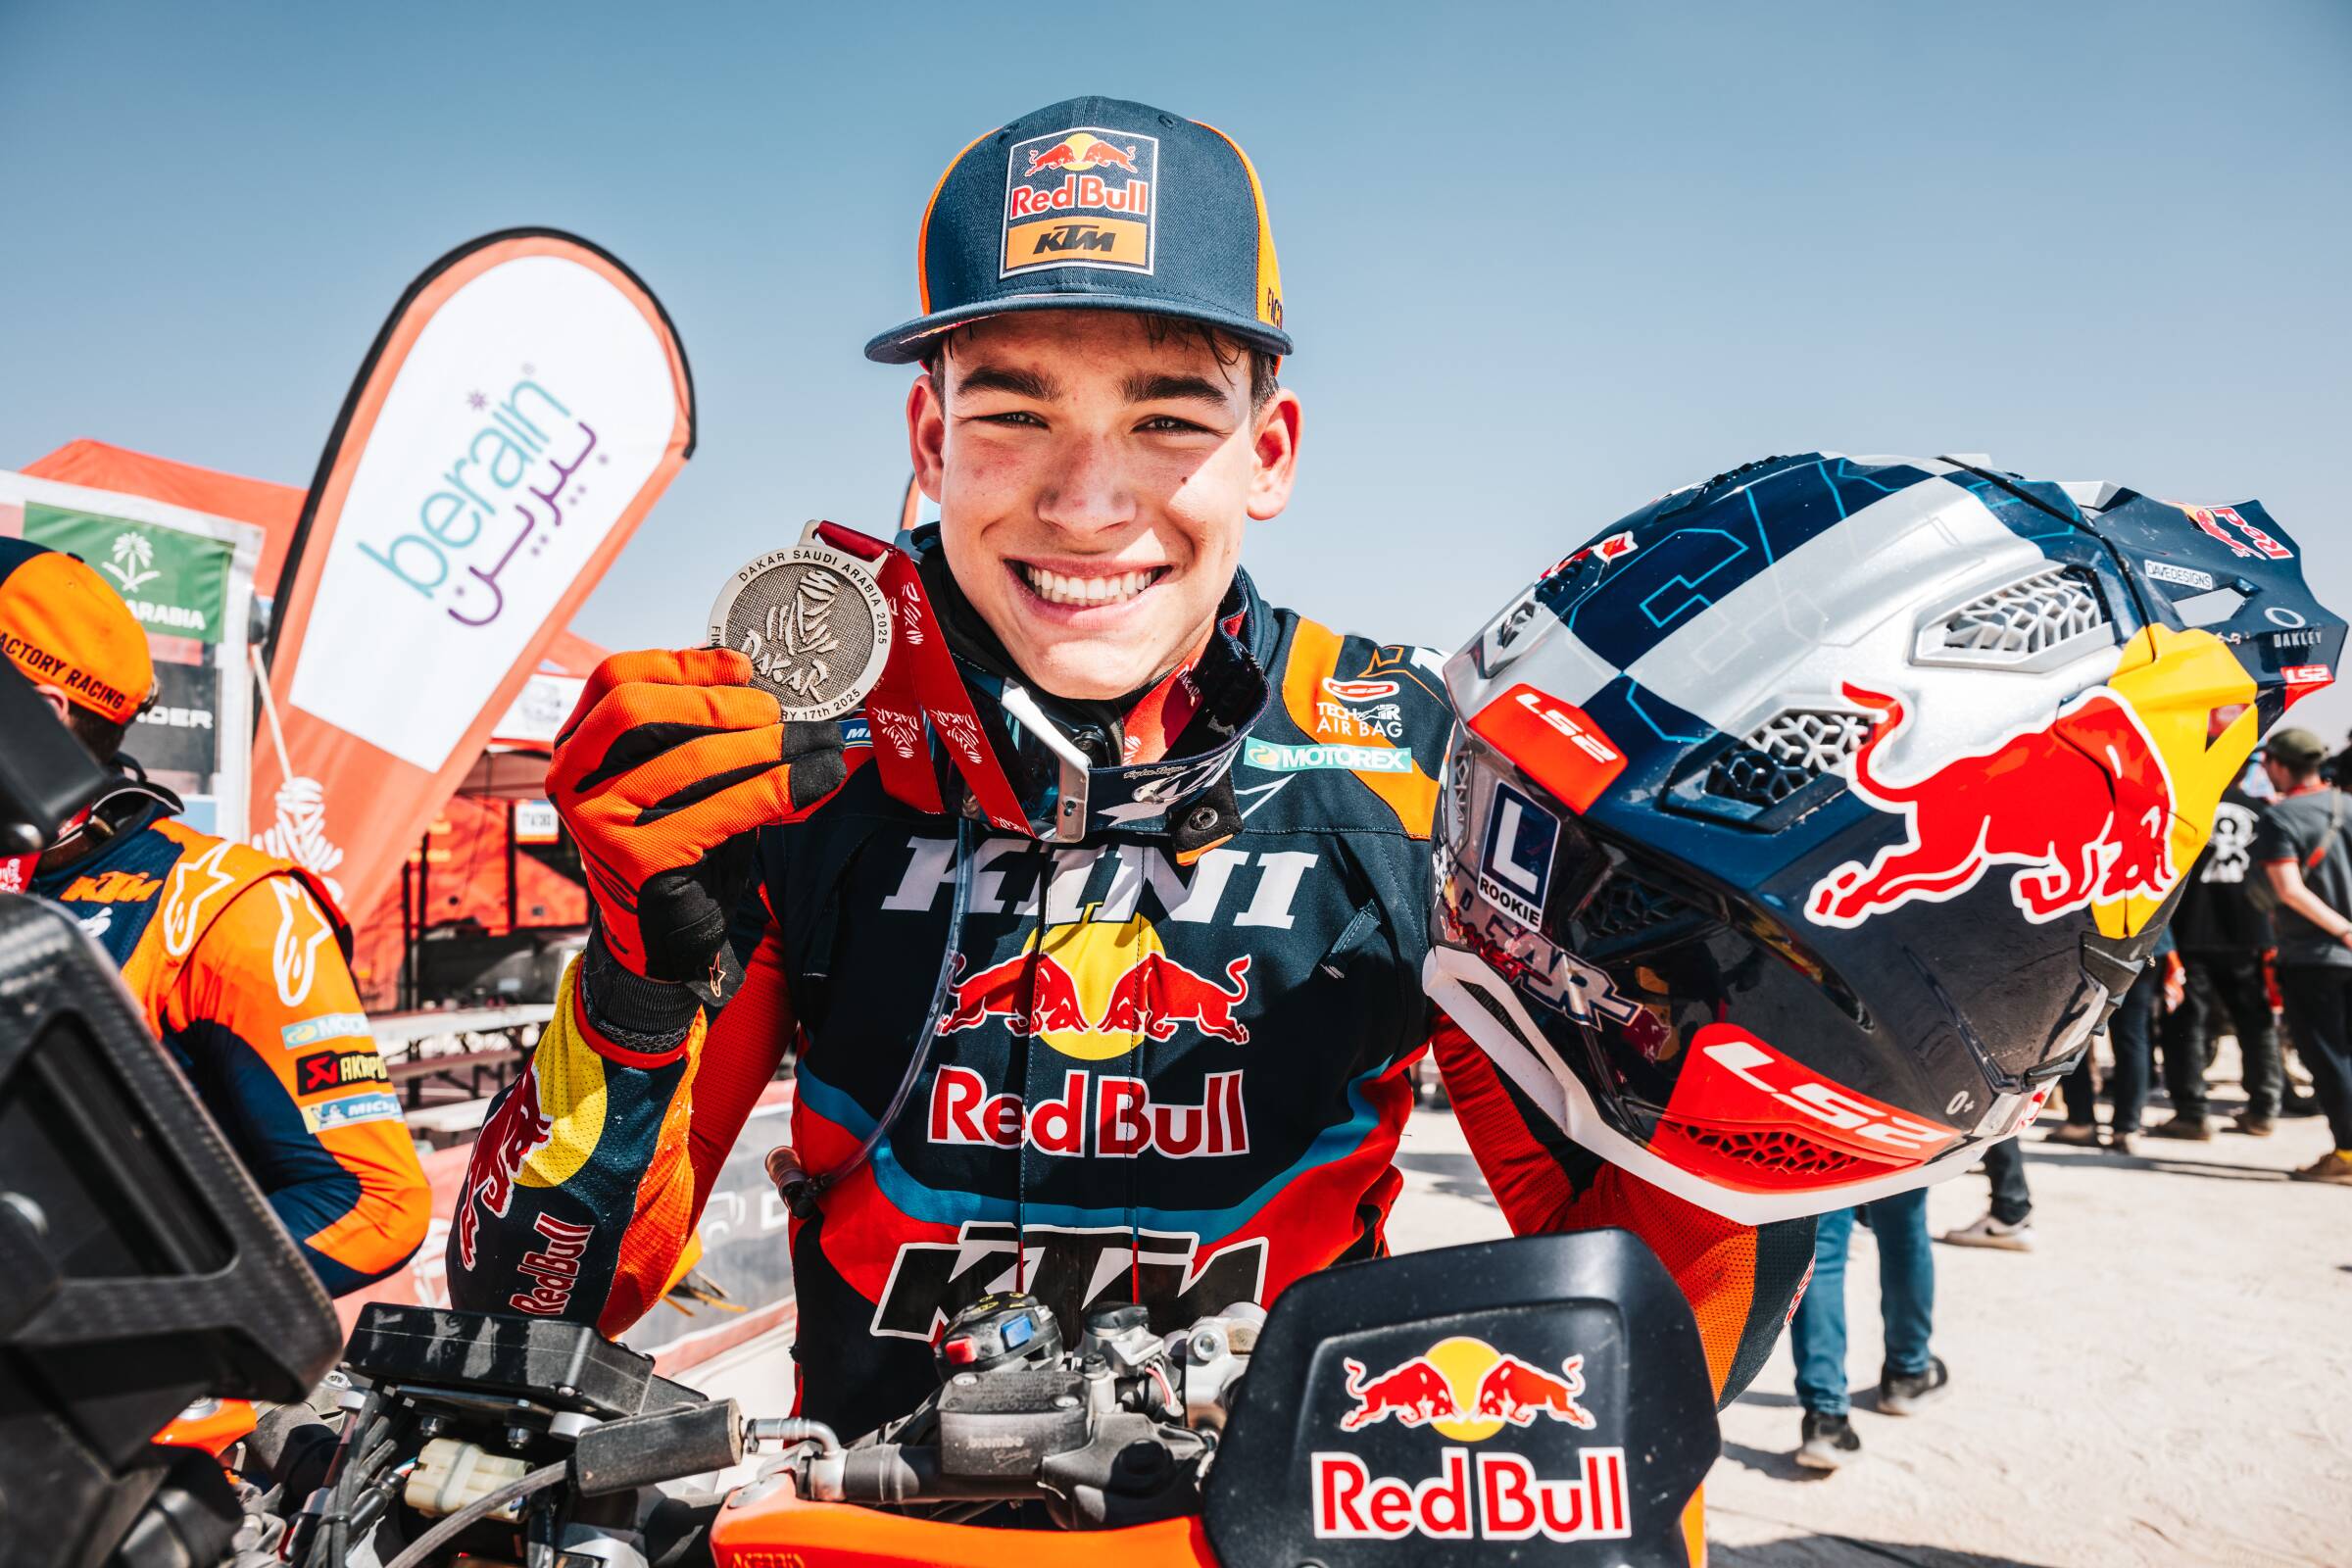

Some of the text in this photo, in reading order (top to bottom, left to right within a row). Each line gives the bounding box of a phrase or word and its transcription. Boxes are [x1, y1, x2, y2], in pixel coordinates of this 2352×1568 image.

[1009, 173, 1150, 220] Red Bull
[1032, 224, 1116, 256] KTM
[357, 378, 571, 599] berain
[738, 553, 785, 582] DAKAR
[793, 550, 838, 565] SAUDI
[841, 563, 881, 608] ARABIA
[876, 612, 887, 645] 2025
[2273, 630, 2322, 649] OAKLEY
[65, 669, 126, 710] RACING
[740, 628, 828, 703] DAKAR
[2286, 668, 2328, 683] LS2
[803, 708, 830, 721] 17th
[833, 688, 860, 711] 2025
[1316, 715, 1403, 738] AIR BAG
[1514, 692, 1619, 764] LS2
[60, 871, 165, 904] KTM
[881, 836, 1320, 930] KINI
[1480, 876, 1541, 926] ROOKIE
[927, 1064, 1250, 1160] Red Bull
[1703, 1042, 1952, 1150] LS2
[508, 1211, 596, 1316] Red Bull
[966, 1434, 1025, 1449] brembo
[1310, 1446, 1632, 1543] Red Bull
